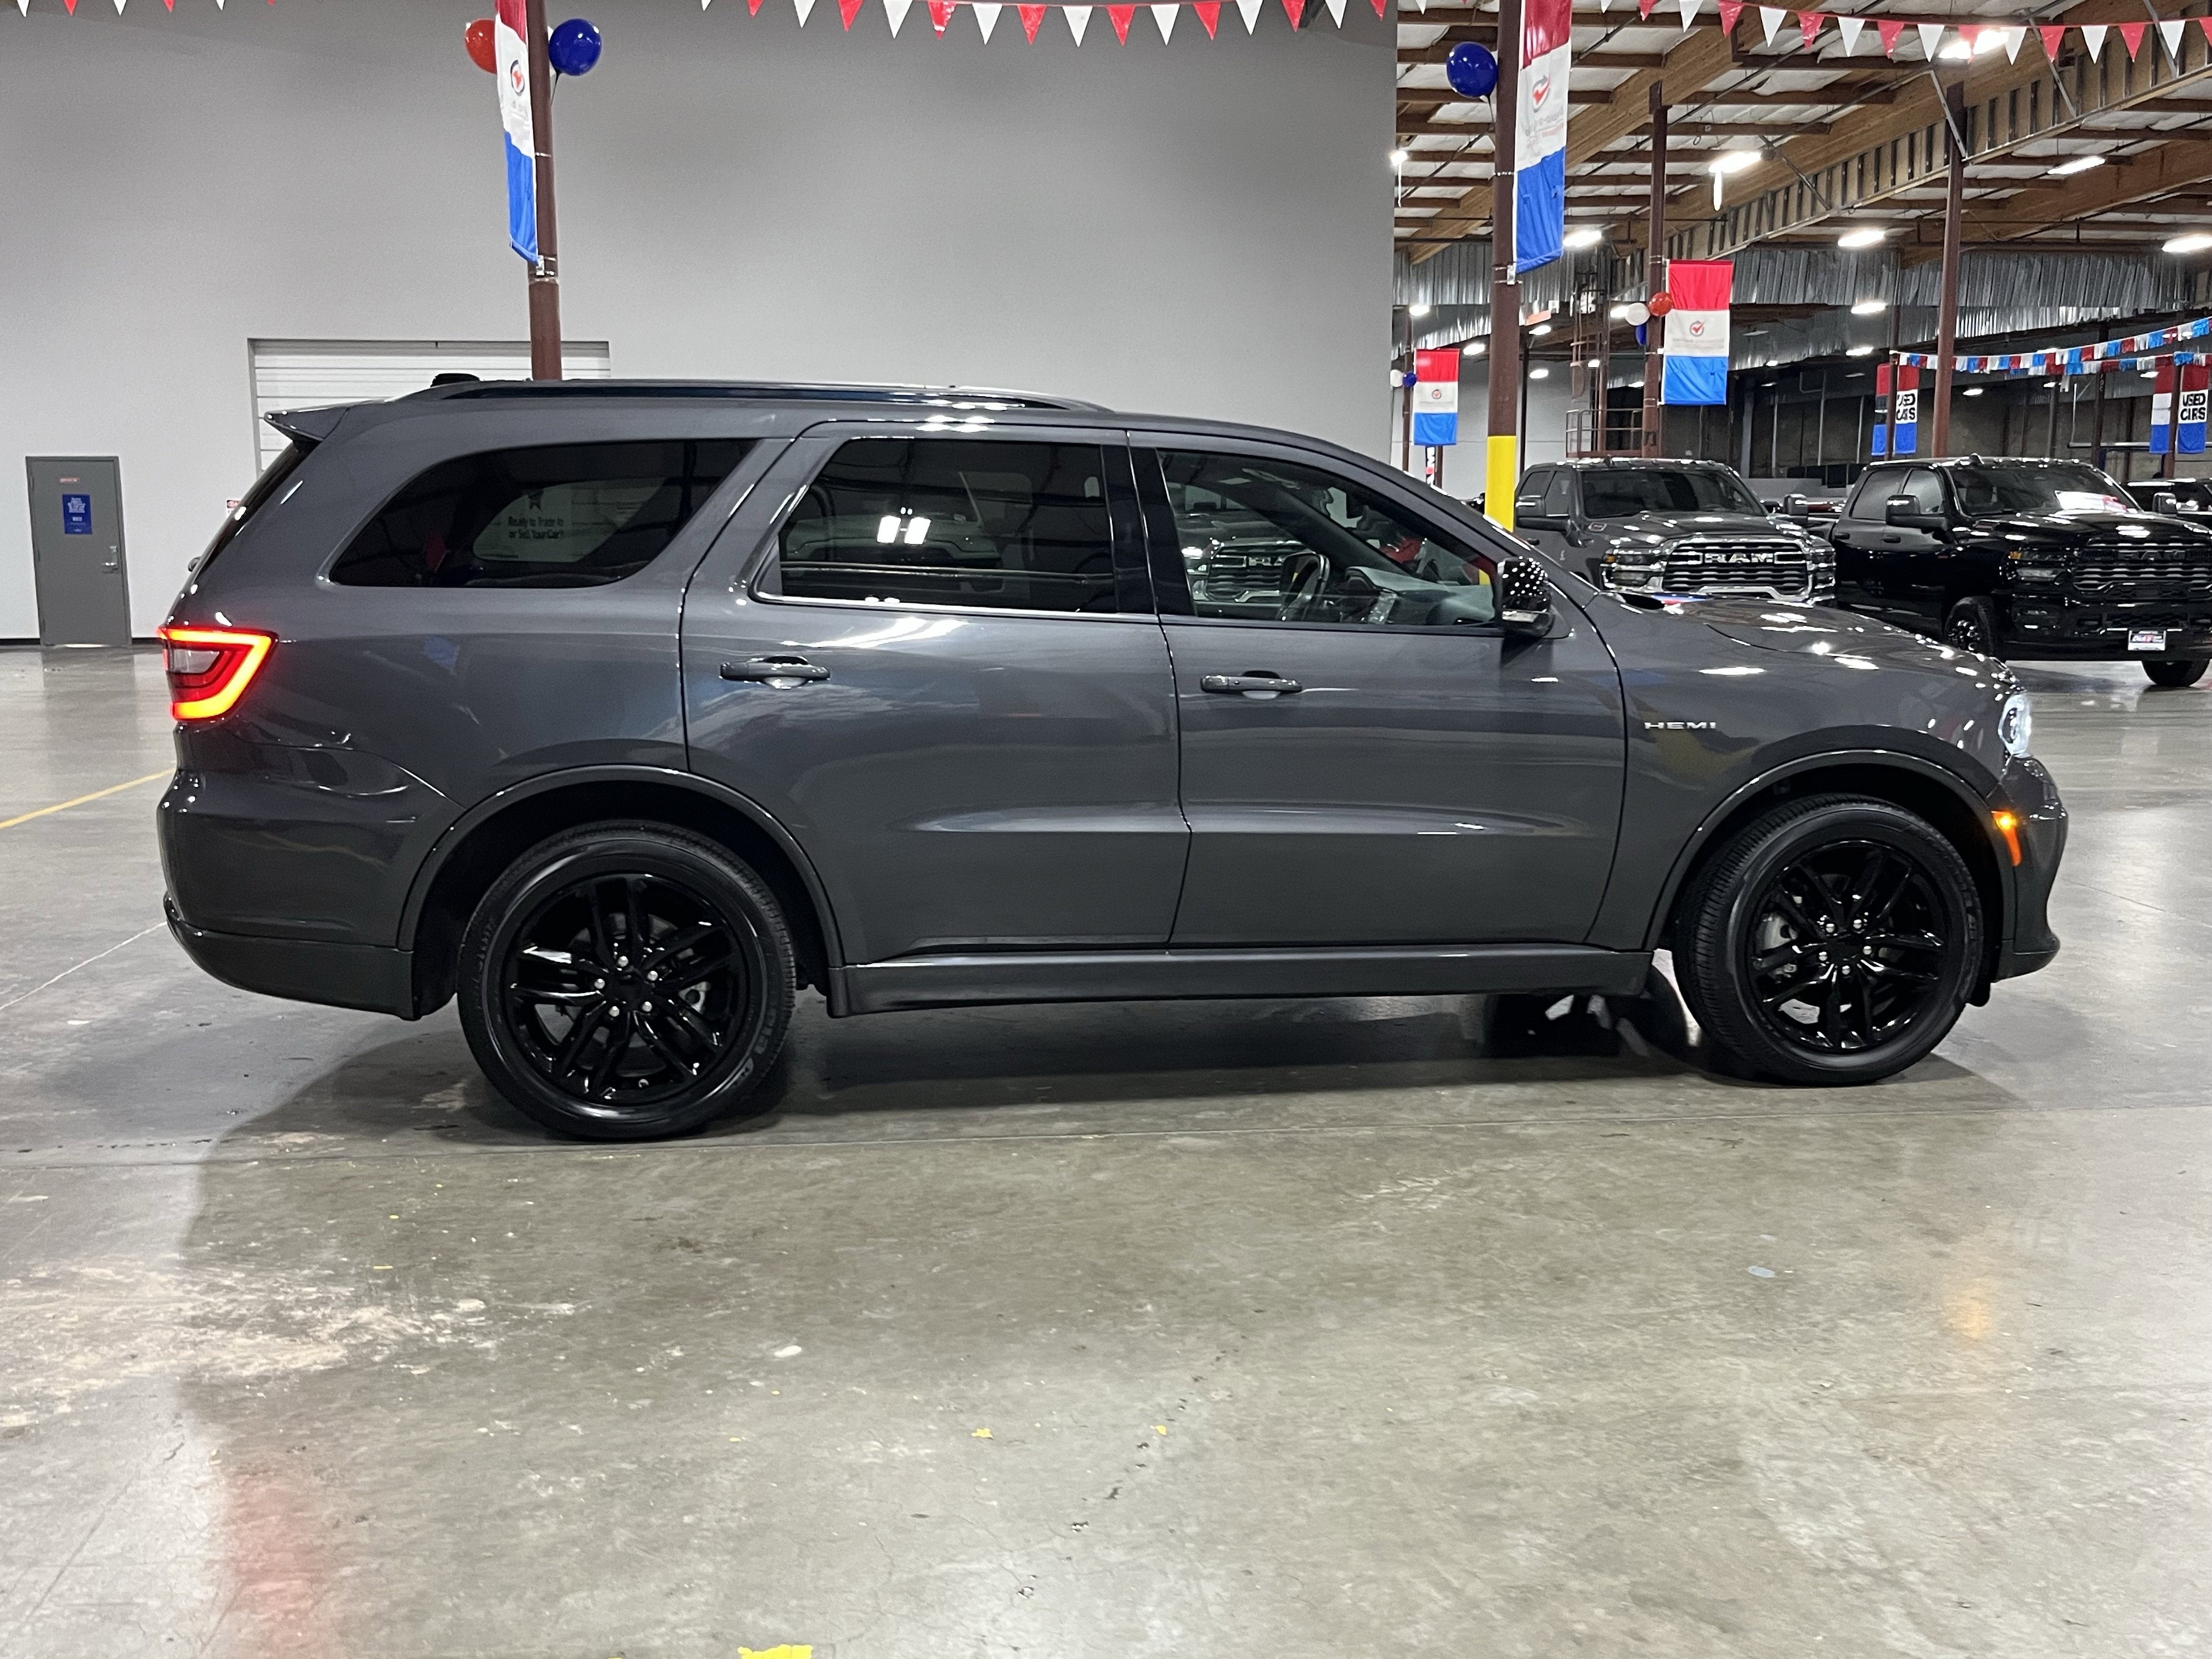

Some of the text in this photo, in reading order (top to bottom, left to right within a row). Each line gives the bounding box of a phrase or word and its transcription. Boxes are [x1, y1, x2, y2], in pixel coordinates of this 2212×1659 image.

[1897, 393, 1915, 407] UED
[2183, 393, 2206, 407] USED
[1705, 552, 1774, 563] RAM
